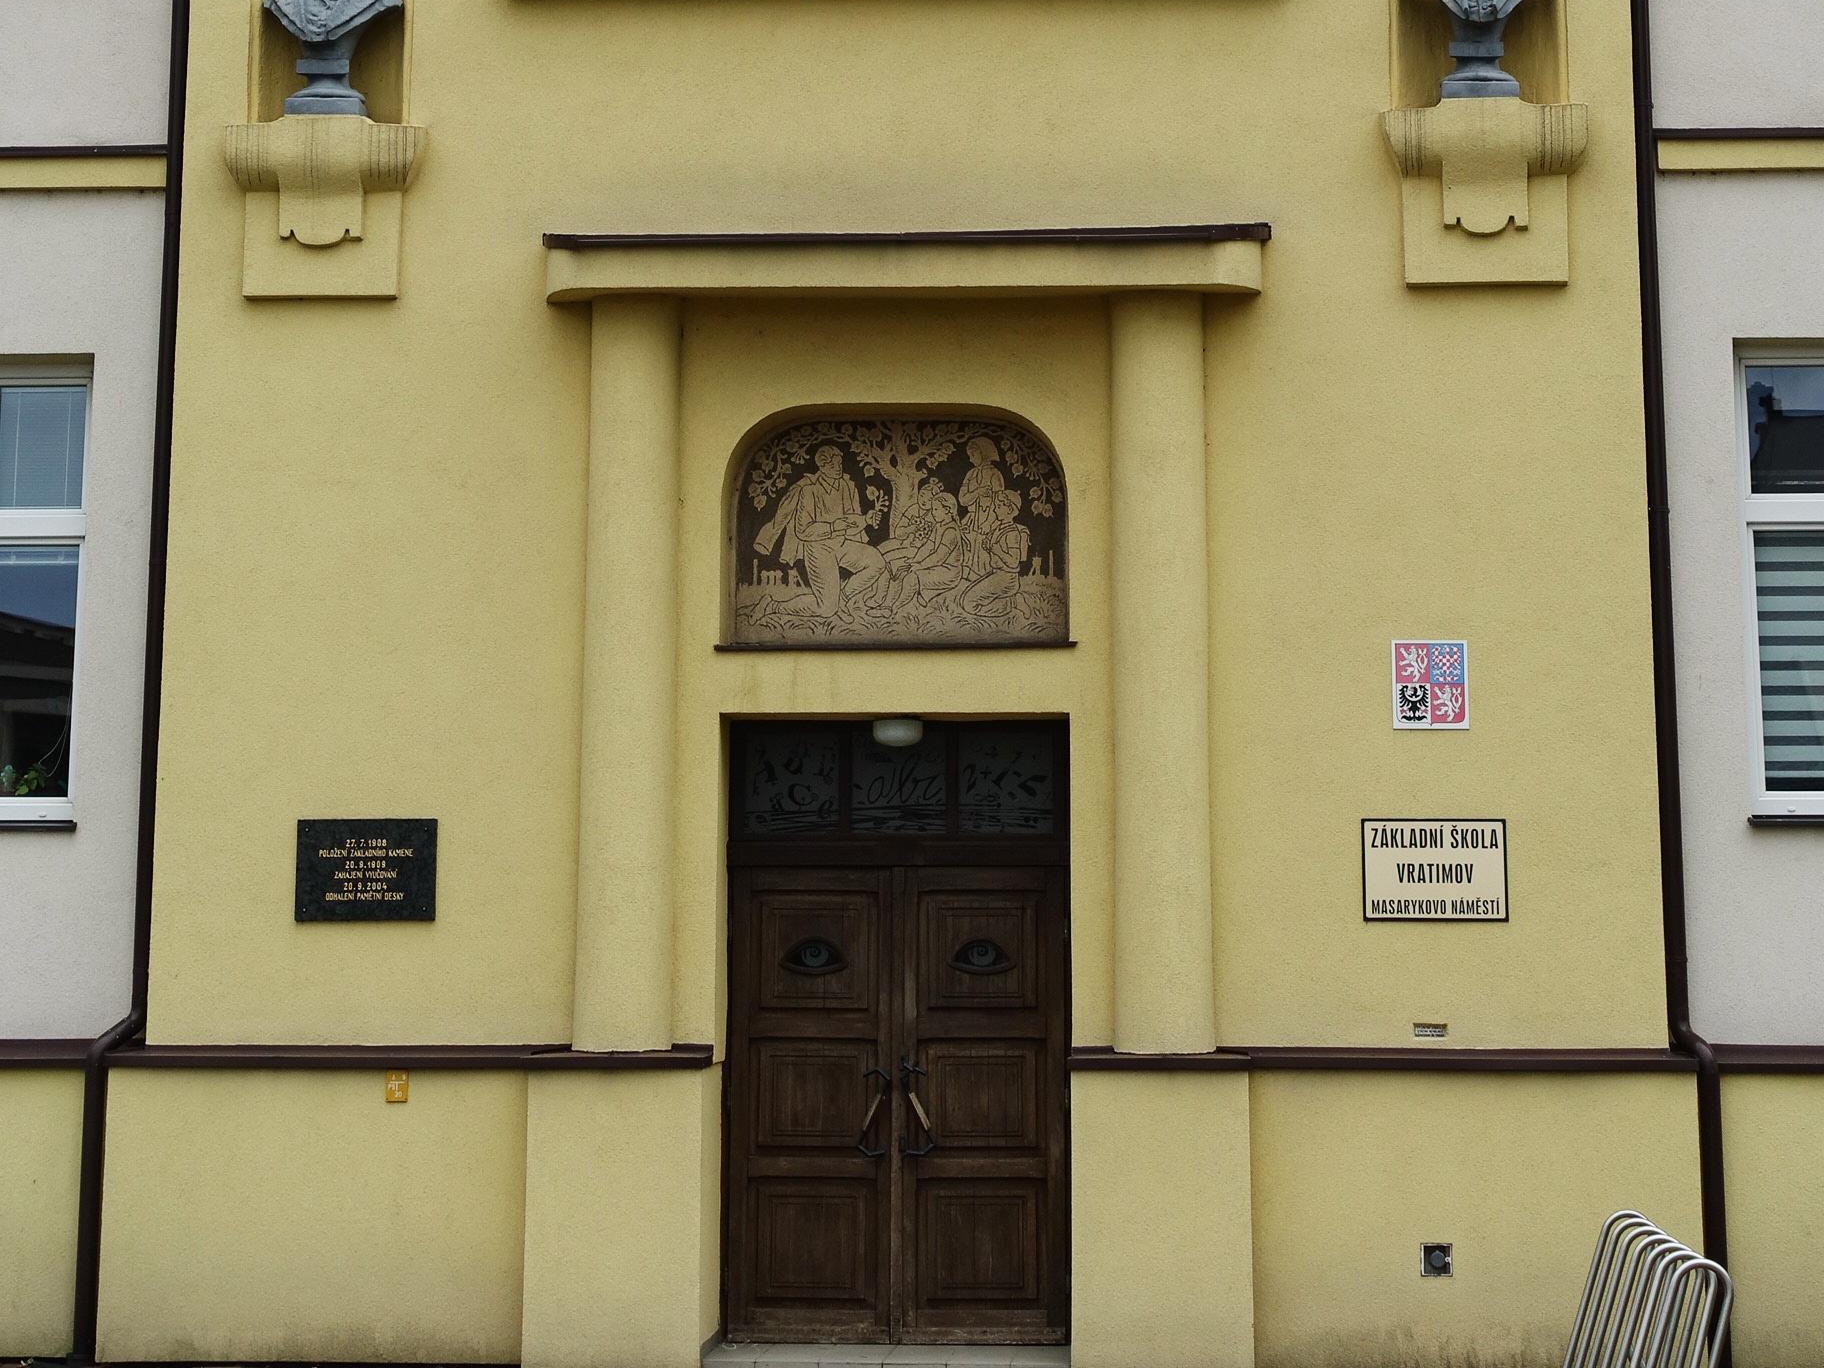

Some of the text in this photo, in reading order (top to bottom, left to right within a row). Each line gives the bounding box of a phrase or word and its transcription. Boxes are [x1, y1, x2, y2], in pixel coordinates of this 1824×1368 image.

[1371, 824, 1499, 849] ZÁKLADNÍ ŠKOLA
[1396, 863, 1474, 884] VRATIMOV
[1371, 897, 1500, 915] MASARYKOVO NÁMĚSTÍ
